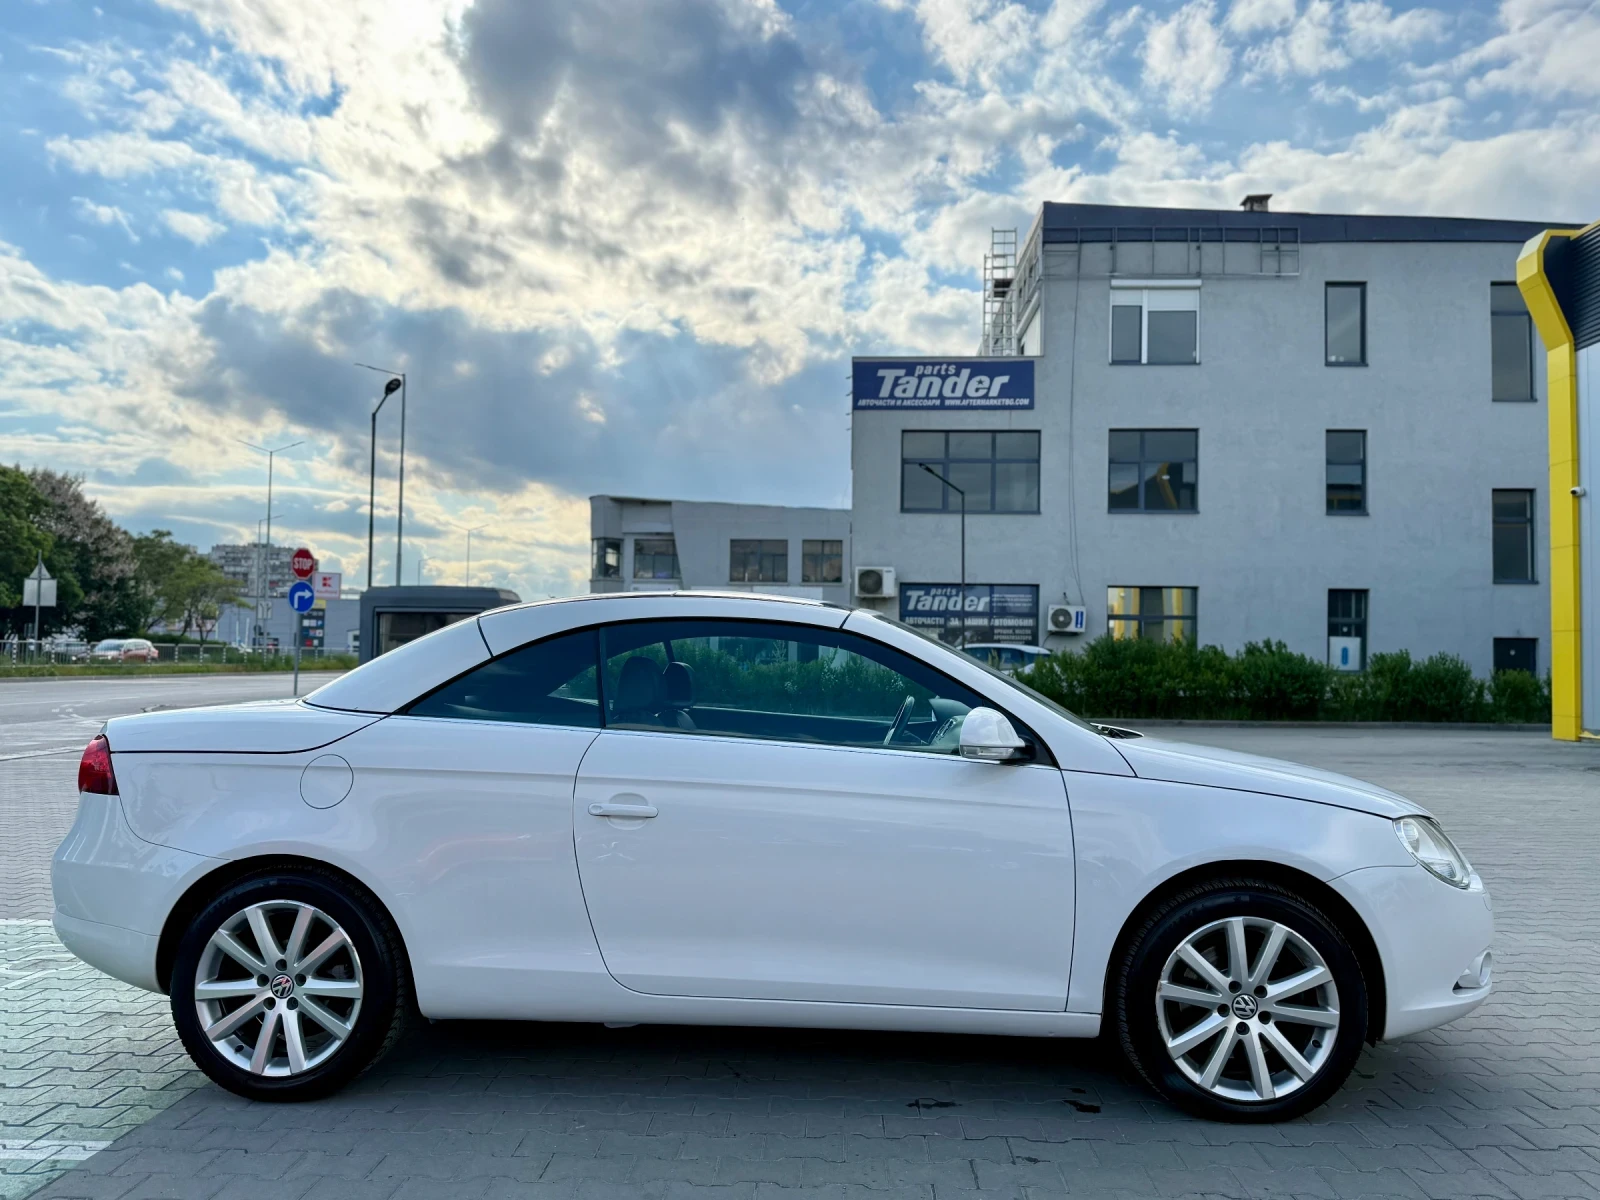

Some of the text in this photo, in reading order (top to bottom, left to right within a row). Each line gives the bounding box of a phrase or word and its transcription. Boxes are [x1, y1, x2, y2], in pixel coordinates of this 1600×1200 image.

[915, 363, 957, 377] parts
[877, 368, 1010, 398] Tander
[293, 558, 313, 570] STOP
[930, 587, 957, 597] parts
[905, 590, 990, 611] Tander
